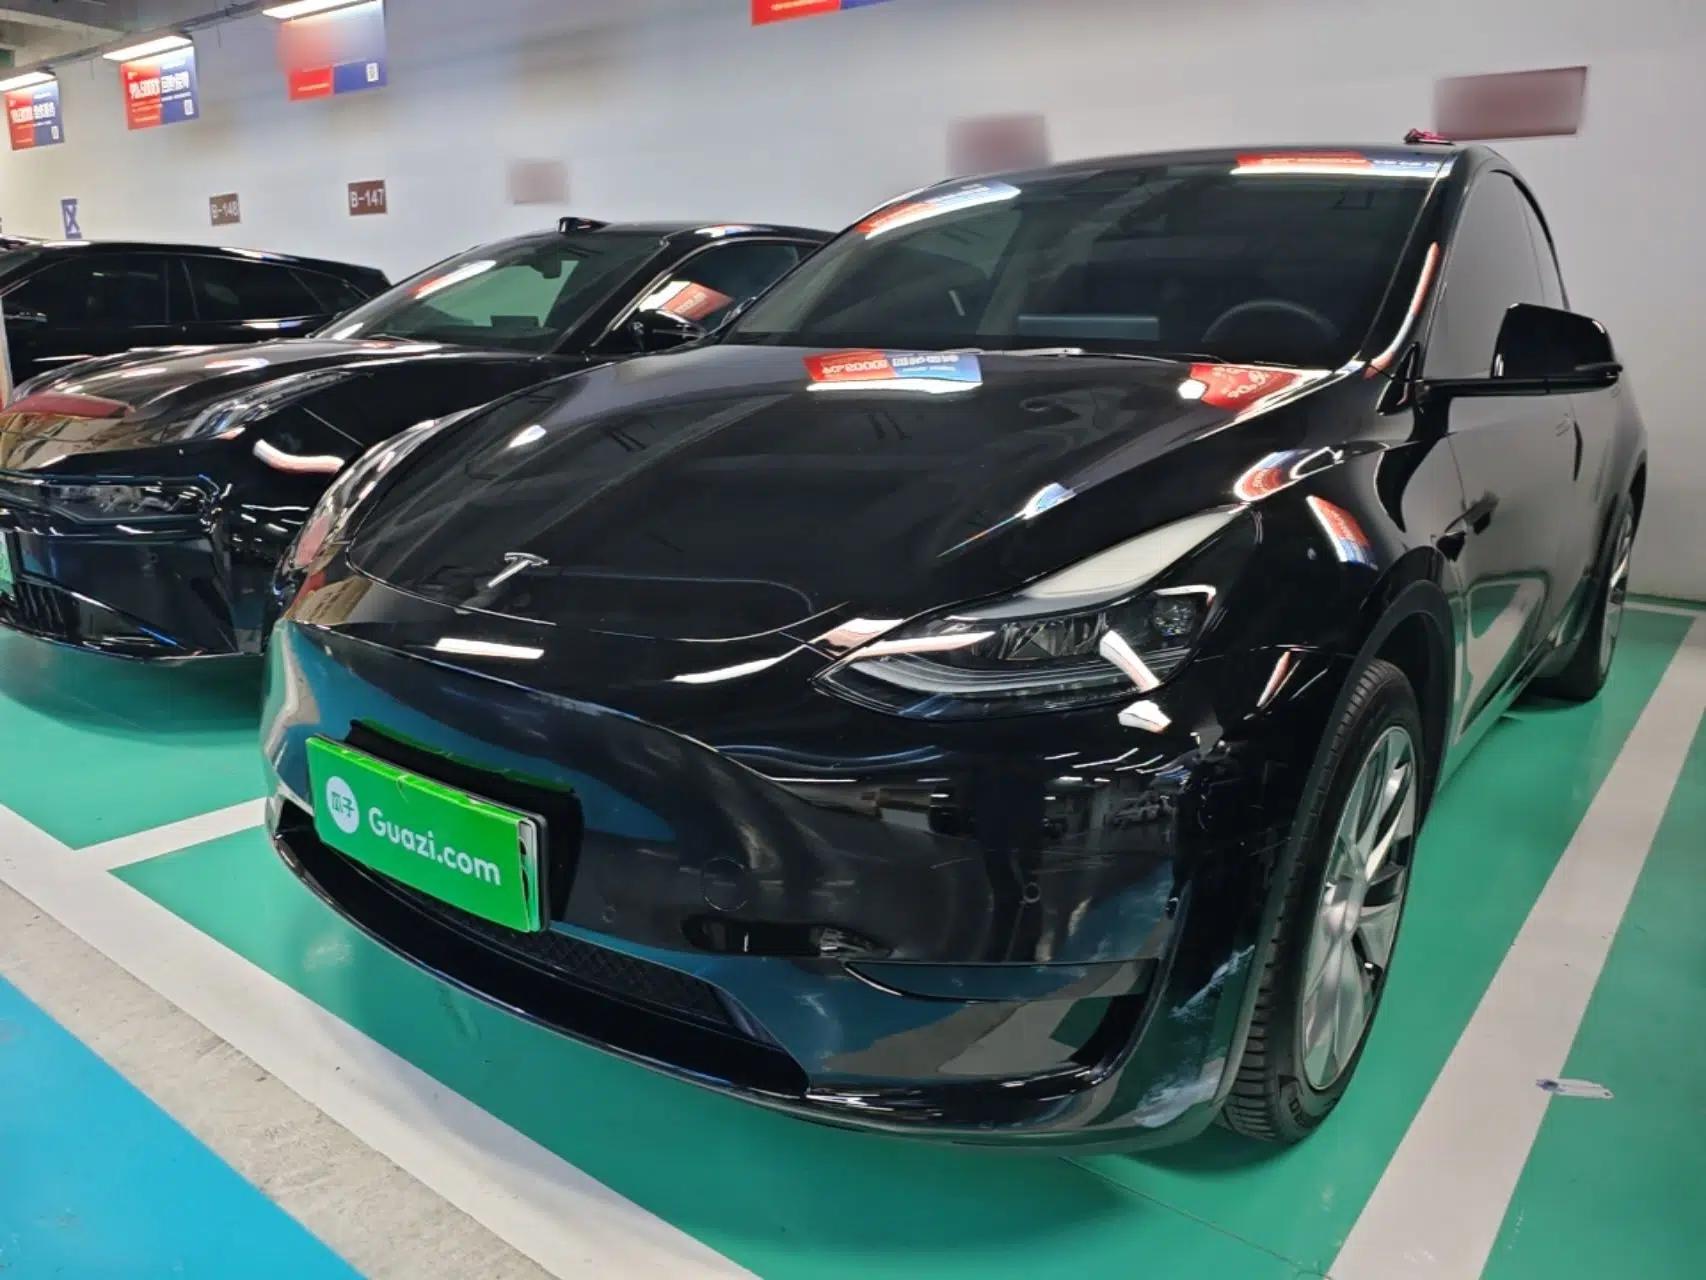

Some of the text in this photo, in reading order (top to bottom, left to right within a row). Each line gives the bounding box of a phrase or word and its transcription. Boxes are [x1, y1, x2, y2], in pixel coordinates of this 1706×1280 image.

[350, 189, 385, 208] B-147
[331, 791, 354, 818] 瓜子
[369, 807, 501, 886] Guazi.com
